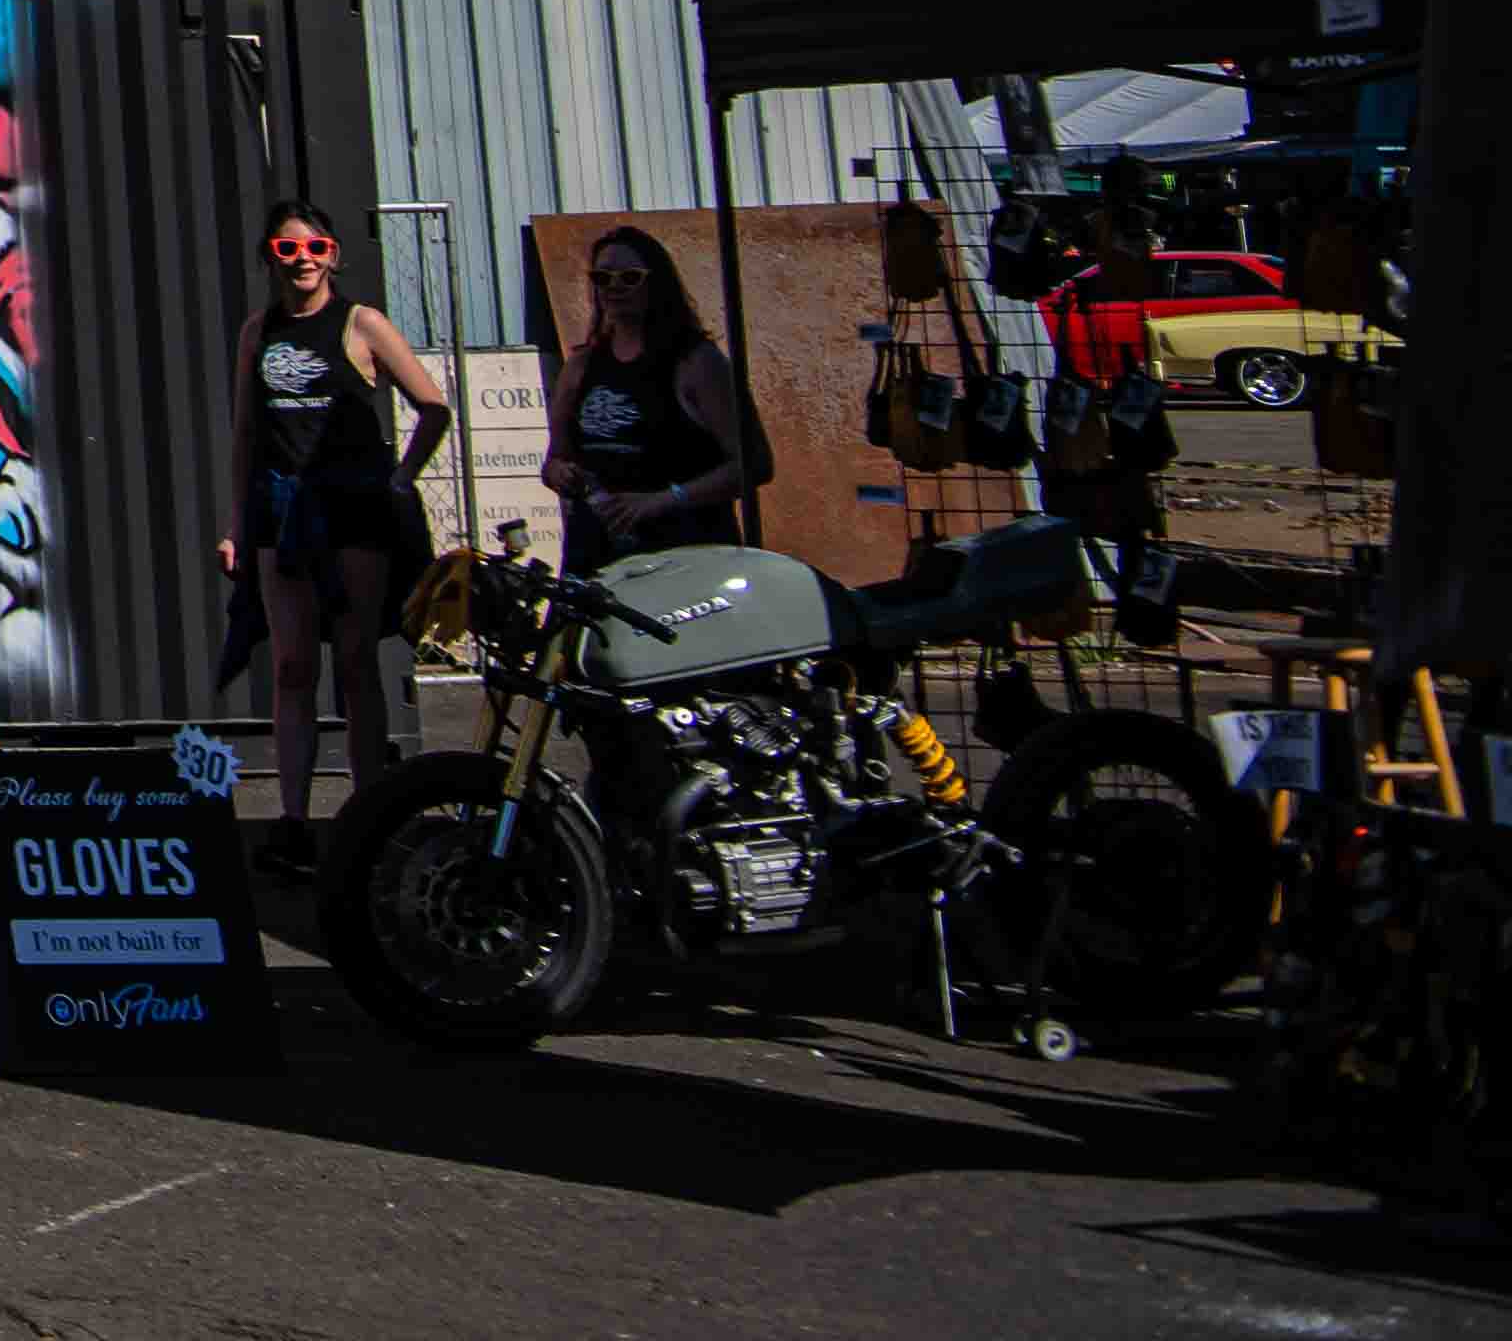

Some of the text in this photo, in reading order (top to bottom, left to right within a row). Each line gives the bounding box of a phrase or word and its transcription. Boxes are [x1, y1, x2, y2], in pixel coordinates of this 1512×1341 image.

[654, 596, 731, 628] ONDA
[178, 737, 229, 786] $30
[82, 774, 126, 822] buy
[135, 788, 192, 807] some
[14, 836, 197, 897] GLOVES
[31, 929, 204, 952] I'm not built for
